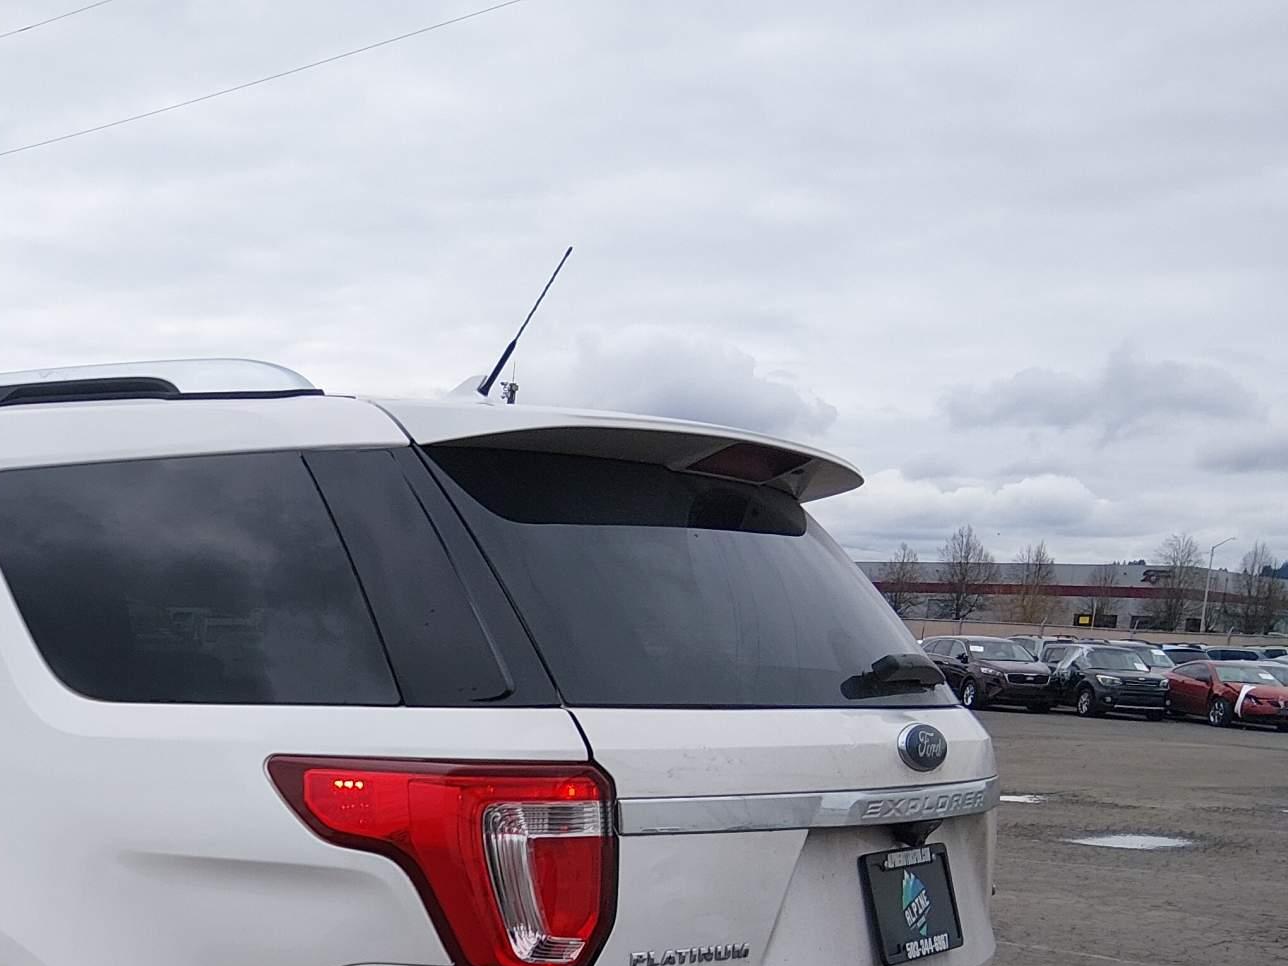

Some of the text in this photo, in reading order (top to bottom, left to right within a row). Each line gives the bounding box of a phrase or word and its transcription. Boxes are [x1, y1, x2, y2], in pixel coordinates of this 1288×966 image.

[918, 730, 942, 757] Ford
[862, 790, 984, 819] EXPLORER
[904, 889, 930, 927] ALPINE
